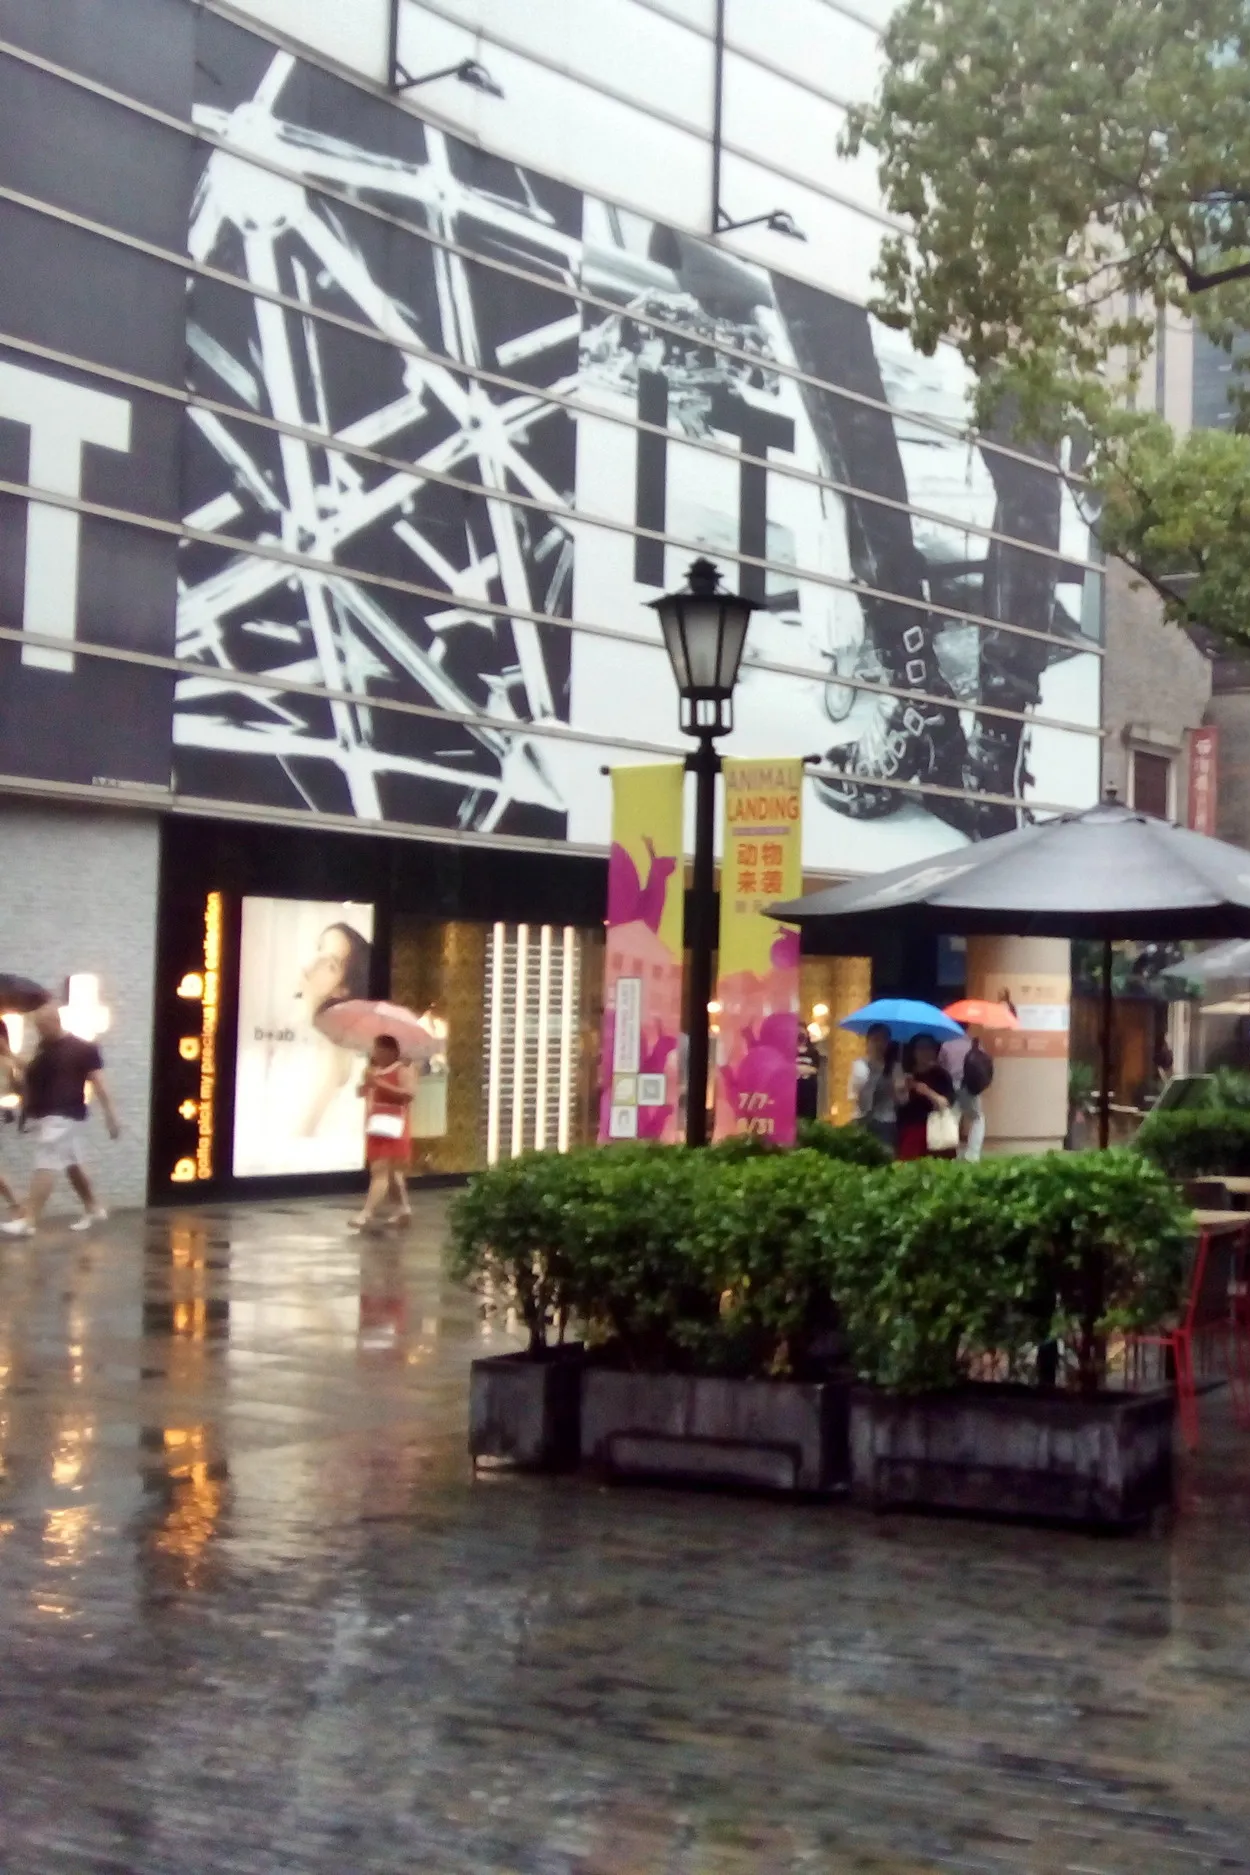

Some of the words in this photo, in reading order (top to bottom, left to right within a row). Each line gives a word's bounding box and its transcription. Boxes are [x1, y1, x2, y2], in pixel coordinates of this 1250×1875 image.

[728, 768, 799, 791] ANIMAL
[728, 796, 799, 821] LANDING
[736, 842, 783, 867] 动物
[736, 870, 783, 894] 来袭
[201, 1006, 217, 1074] precious
[200, 1075, 214, 1099] my
[198, 1101, 213, 1135] pick
